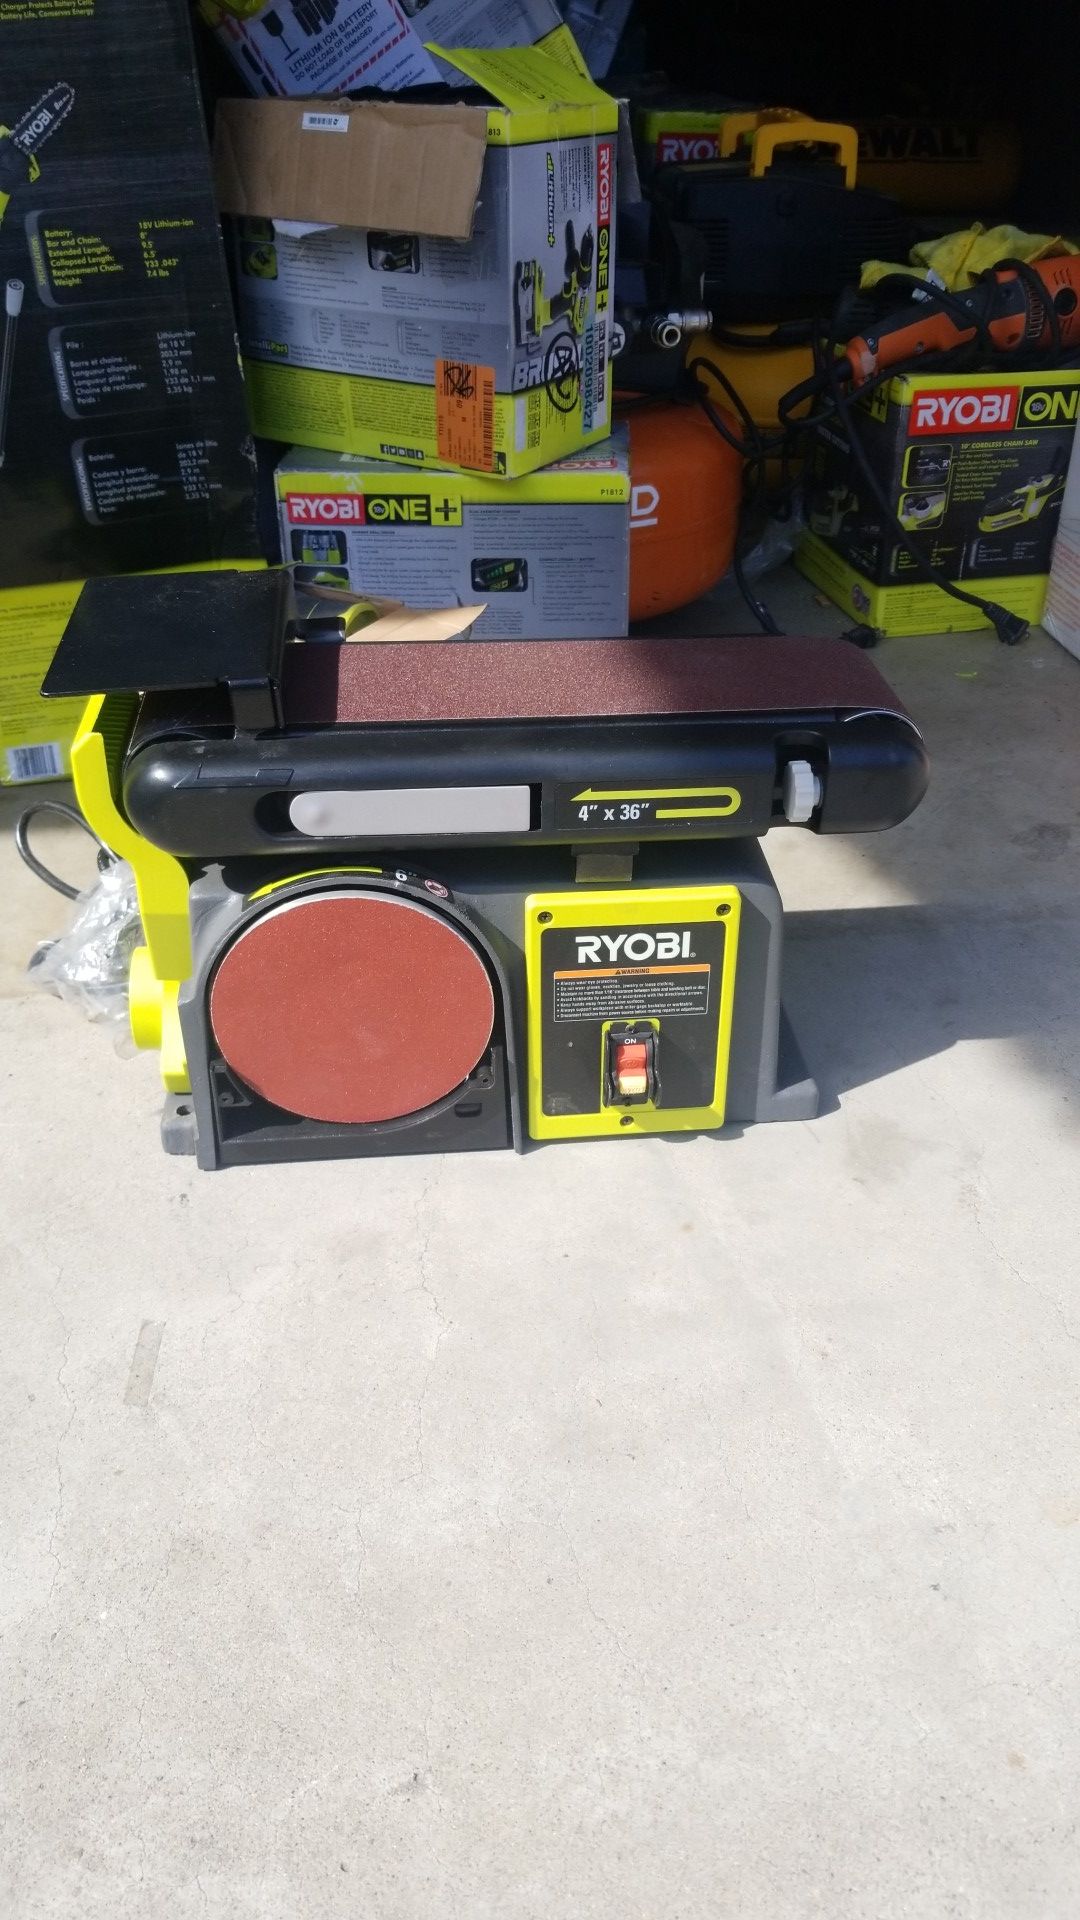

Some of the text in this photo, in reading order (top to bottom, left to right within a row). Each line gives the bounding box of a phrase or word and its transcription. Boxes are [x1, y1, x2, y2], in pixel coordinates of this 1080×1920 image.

[289, 42, 323, 74] LITHIUM
[322, 29, 339, 46] ION
[337, 0, 374, 33] BATTERY
[344, 9, 379, 39] TRANSPORT
[344, 26, 374, 53] DAMAGED
[19, 108, 54, 146] RYOBI
[662, 138, 719, 162] RYO
[599, 147, 611, 224] RYOBI
[916, 390, 1080, 428] RYOBI ON
[971, 440, 1004, 450] CORDLESS
[1003, 439, 1025, 449] CHAIN
[1024, 438, 1040, 447] SAW
[600, 488, 625, 497] P1812
[289, 497, 361, 520] RYOBI
[603, 808, 616, 821] x
[619, 803, 651, 821] 36"
[575, 931, 692, 964] RYOBI
[621, 967, 651, 975] WARNING
